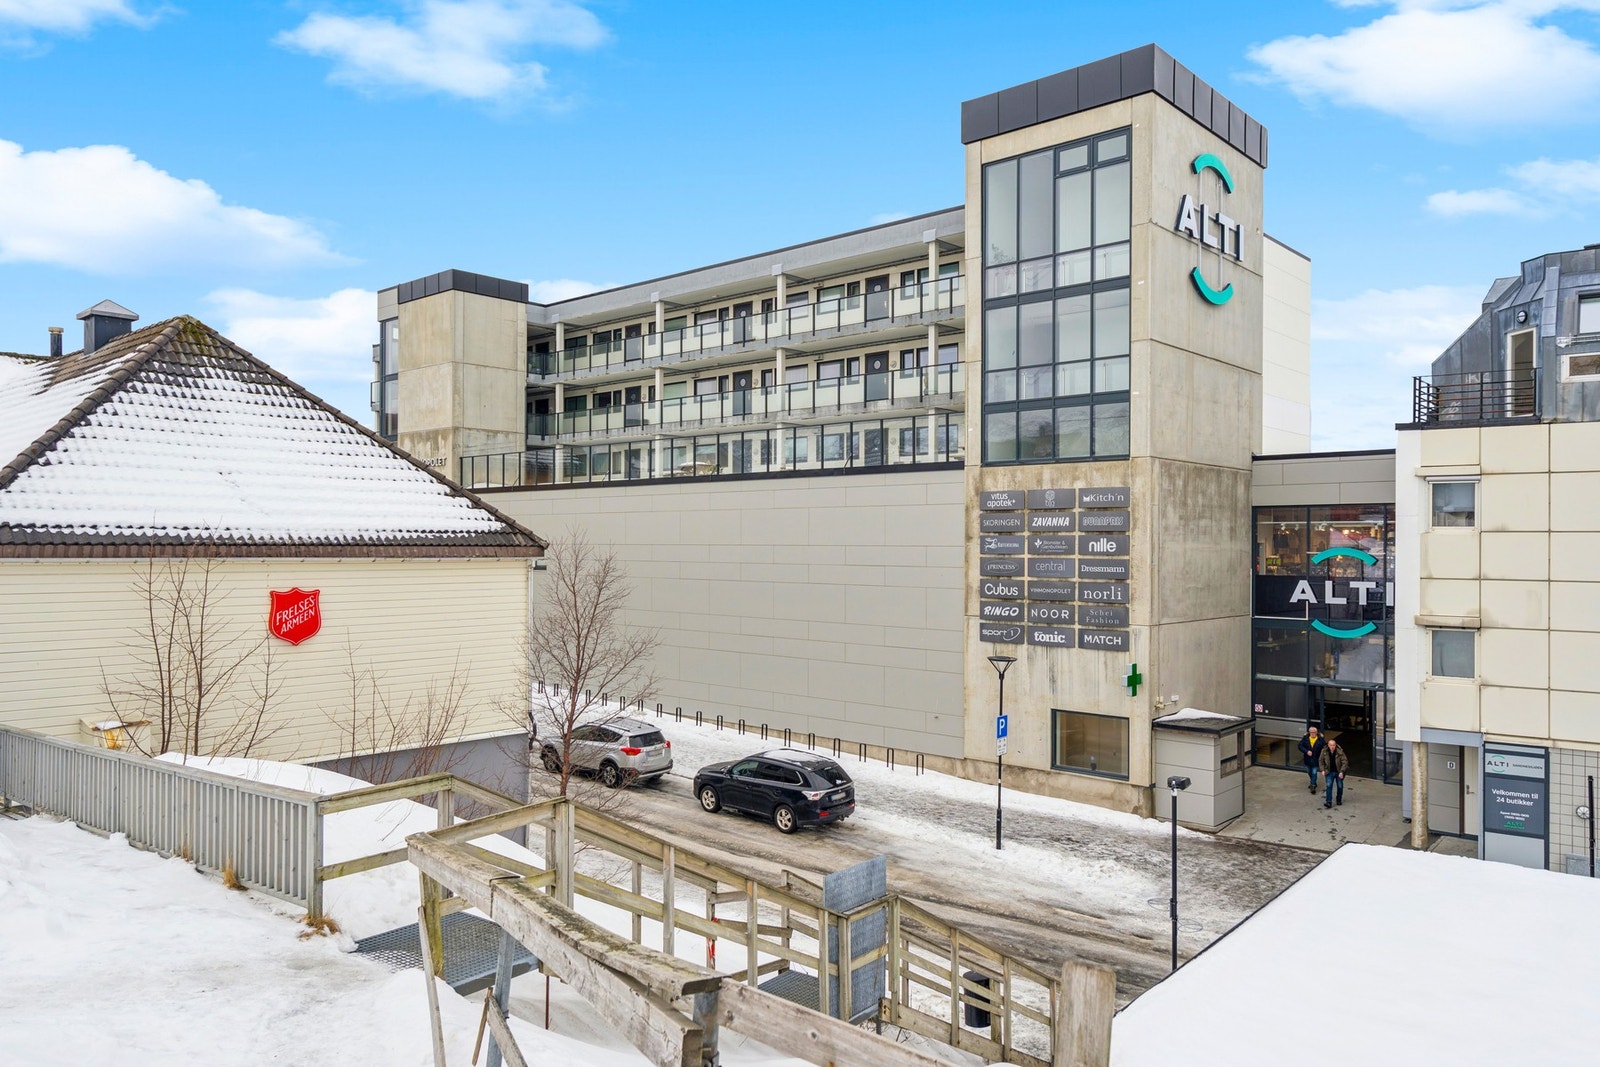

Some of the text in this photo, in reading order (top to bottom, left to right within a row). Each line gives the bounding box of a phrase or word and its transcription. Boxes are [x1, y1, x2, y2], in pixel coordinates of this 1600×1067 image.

[1174, 193, 1245, 263] ALTI
[987, 500, 1013, 509] apotek
[983, 519, 1020, 527] SKORINGEN
[1031, 516, 1070, 527] ZAVANNA
[1088, 538, 1117, 552] nille
[1035, 560, 1066, 571] central
[1081, 565, 1125, 573] Dressmann
[984, 583, 1019, 596] Cubus
[1083, 586, 1122, 600] norli
[1289, 580, 1394, 606] ALTI
[276, 595, 316, 626] FRELSES
[983, 606, 1020, 616] RINGO
[1031, 608, 1070, 619] NOOR
[1089, 609, 1113, 617] Schei
[280, 607, 315, 635] ARMEEN
[1086, 616, 1120, 624] Fashion
[982, 628, 1008, 636] sport
[1084, 634, 1122, 645] MATCH
[999, 718, 1006, 736] P
[1487, 760, 1509, 768] ALTI
[1491, 788, 1530, 798] Velkommen
[1506, 797, 1534, 807] butikker
